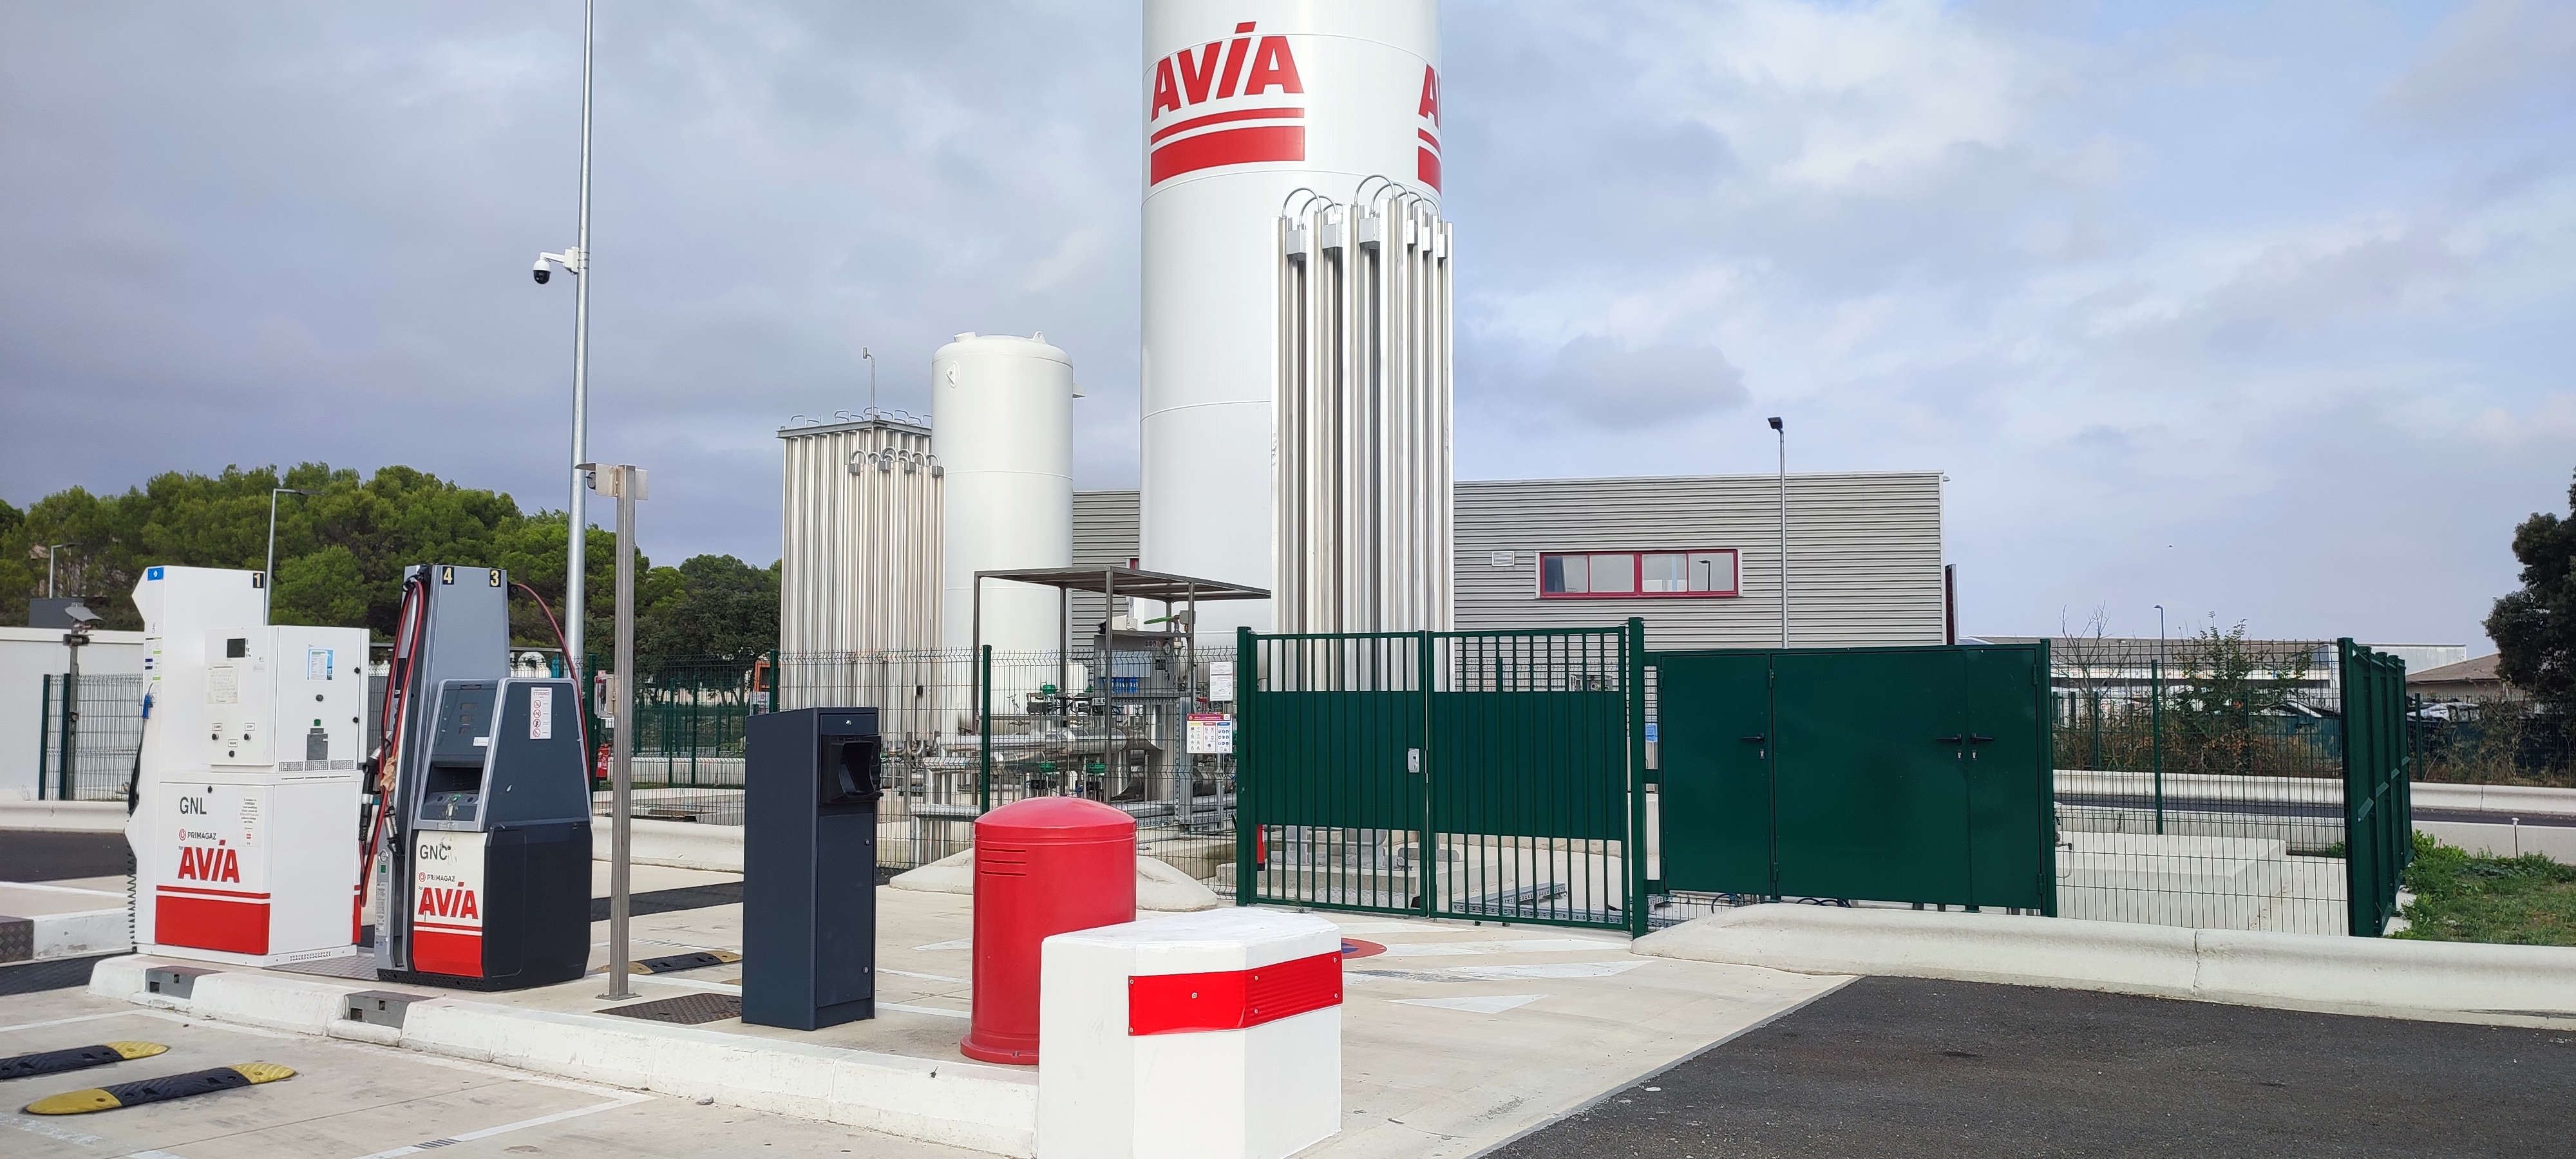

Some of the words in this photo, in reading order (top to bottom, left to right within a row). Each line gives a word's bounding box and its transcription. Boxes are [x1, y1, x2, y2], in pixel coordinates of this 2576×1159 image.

[1151, 21, 1304, 122] AVIA
[254, 573, 260, 587] 1
[444, 568, 453, 583] 4
[491, 570, 499, 587] 3
[180, 796, 207, 815] GNL
[187, 831, 217, 840] PRIMAGAZ
[419, 844, 448, 860] GNC
[178, 839, 240, 883] AVIA
[427, 874, 455, 882] PRIMAGAZ
[418, 881, 478, 919] AVIA
